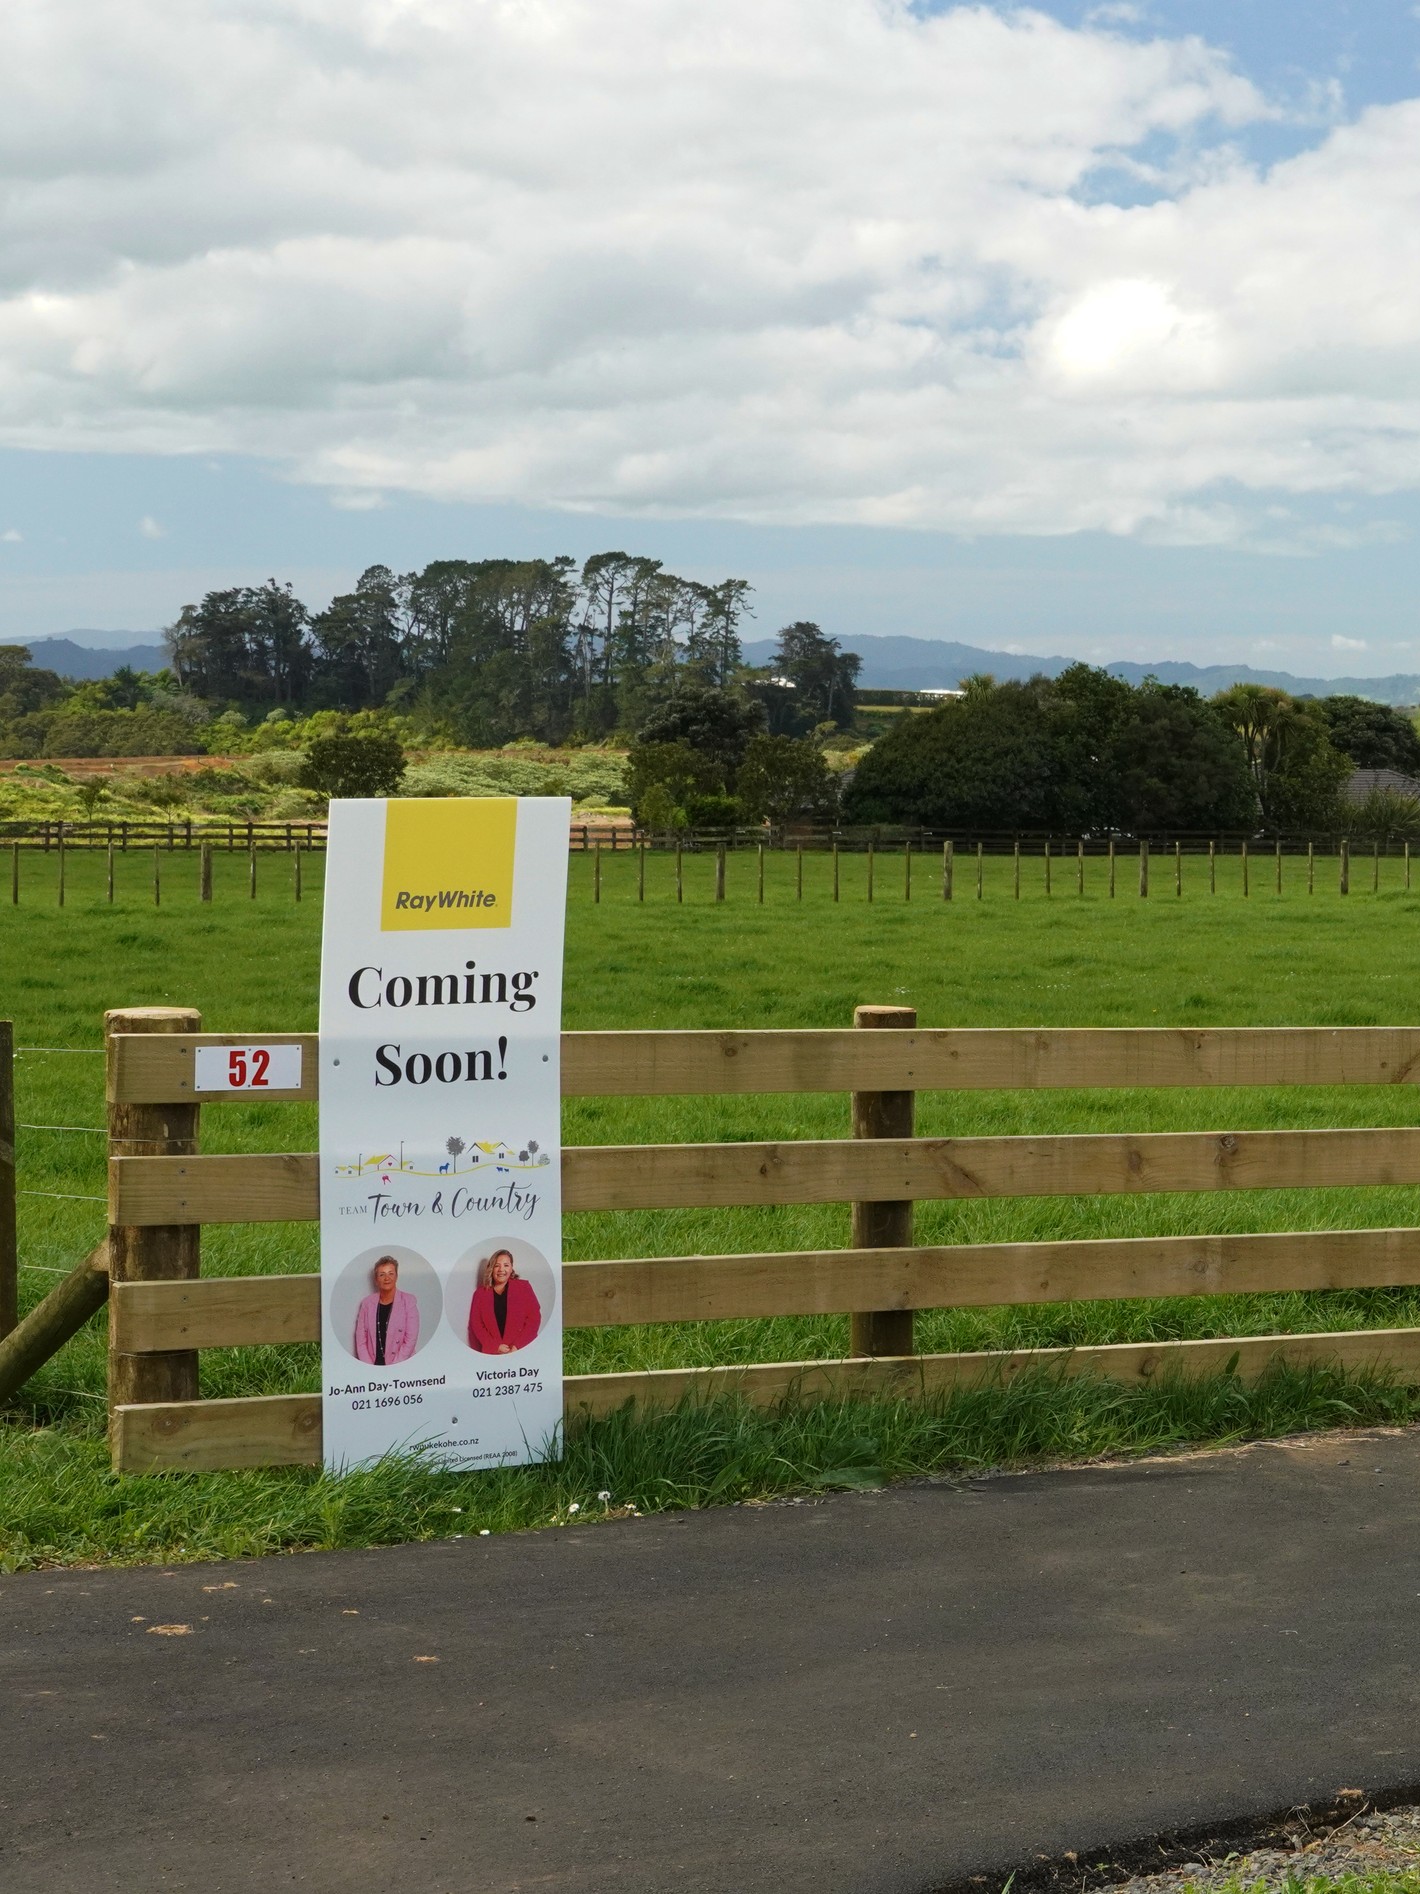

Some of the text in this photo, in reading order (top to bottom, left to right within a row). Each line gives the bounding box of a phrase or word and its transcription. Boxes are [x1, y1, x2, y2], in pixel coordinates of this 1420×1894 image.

[395, 889, 496, 913] RayWhite
[348, 960, 539, 1013] Coming
[228, 1049, 270, 1087] 52
[375, 1036, 508, 1087] Soon!
[338, 1181, 542, 1224] TEAM Town & Country
[476, 1367, 540, 1381] Victoria Day
[328, 1375, 446, 1396] Jo-Ann Day-Townsend
[472, 1382, 543, 1398] 021 2387 475
[352, 1393, 423, 1411] 021 1696 056
[409, 1438, 480, 1452] rwpukekohe.co.nz
[459, 1455, 483, 1463] Licensed
[483, 1453, 502, 1461] (REAA
